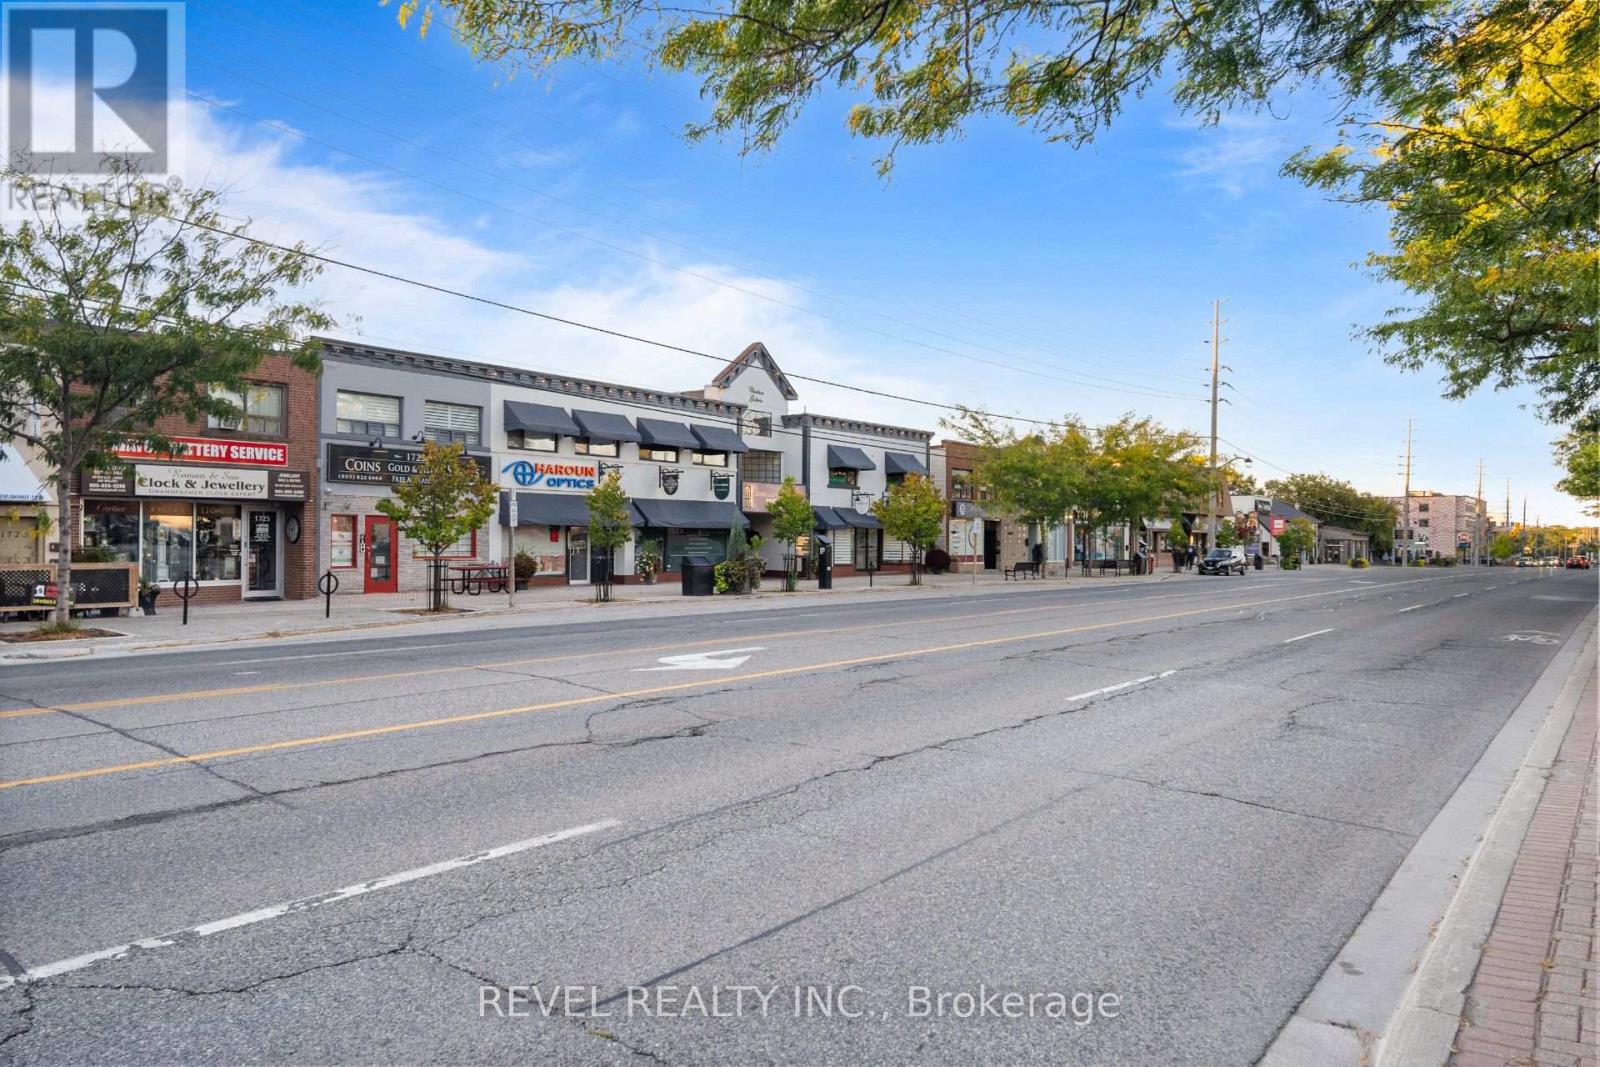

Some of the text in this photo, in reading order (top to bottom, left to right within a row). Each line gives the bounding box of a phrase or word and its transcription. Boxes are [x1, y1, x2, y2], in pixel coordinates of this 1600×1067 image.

[229, 445, 284, 462] SERVICE
[345, 458, 381, 472] COINS
[388, 463, 410, 473] GOLD
[412, 465, 418, 474] &
[534, 463, 595, 477] HAROUN
[138, 476, 179, 489] Clock
[184, 479, 197, 489] &
[201, 479, 266, 494] Jewellery
[547, 477, 594, 489] OPTICS
